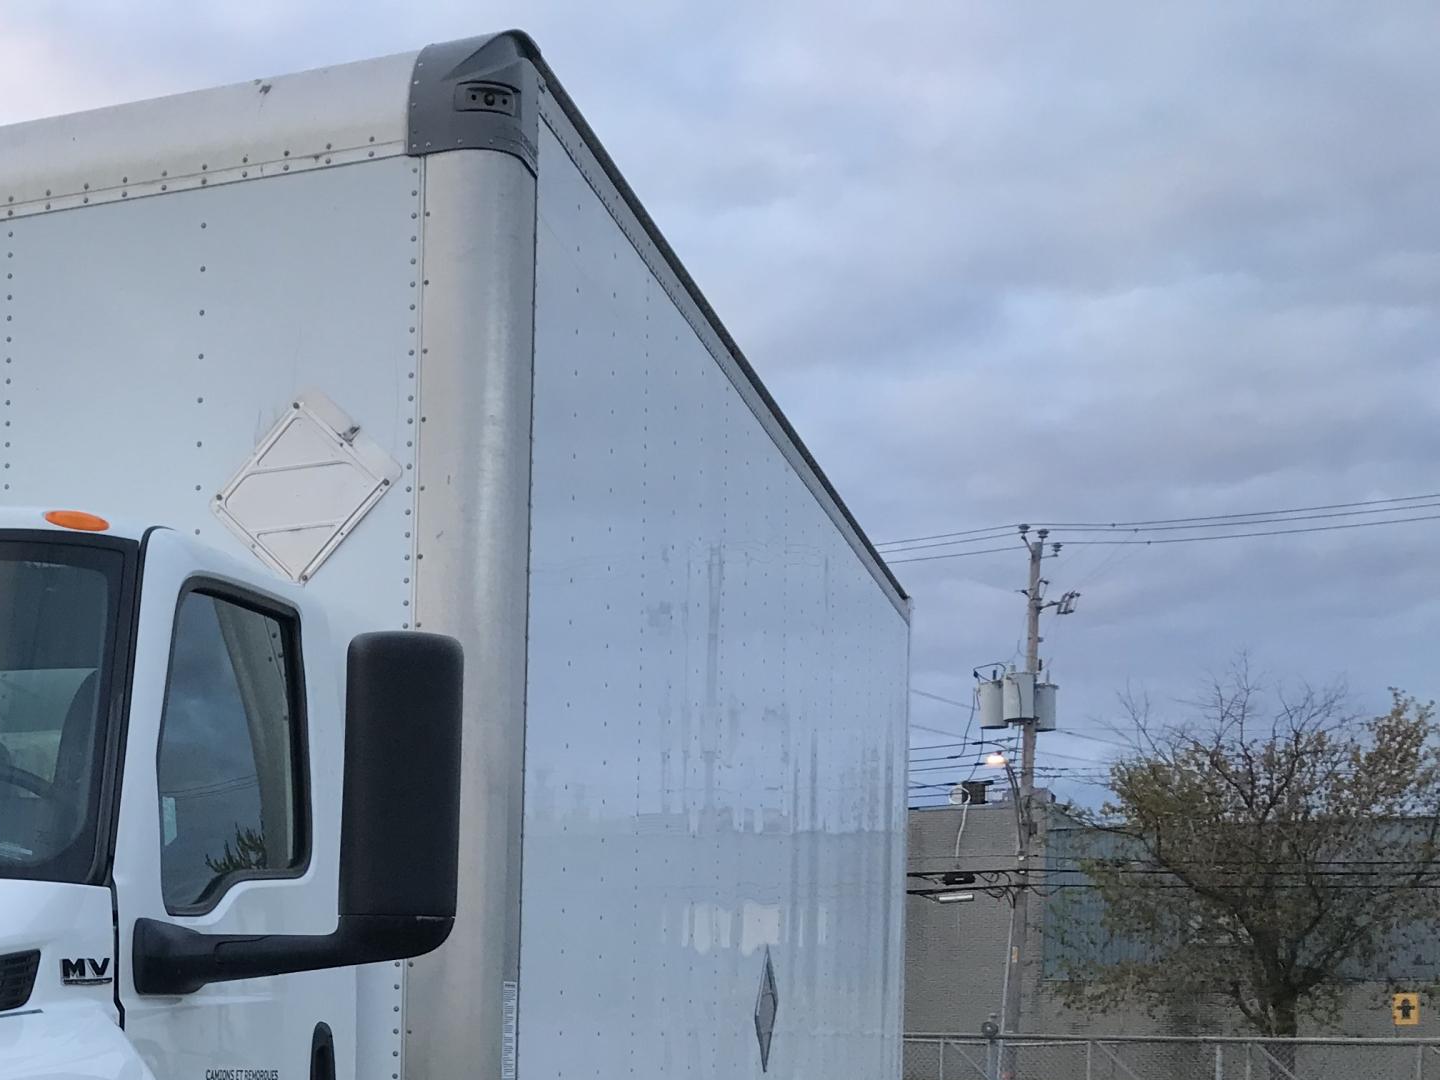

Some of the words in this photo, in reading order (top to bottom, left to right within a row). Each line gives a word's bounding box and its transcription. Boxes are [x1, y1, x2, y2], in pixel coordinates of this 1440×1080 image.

[62, 958, 111, 978] MV
[205, 1069, 235, 1080] CAMIONS
[236, 1069, 244, 1080] ET
